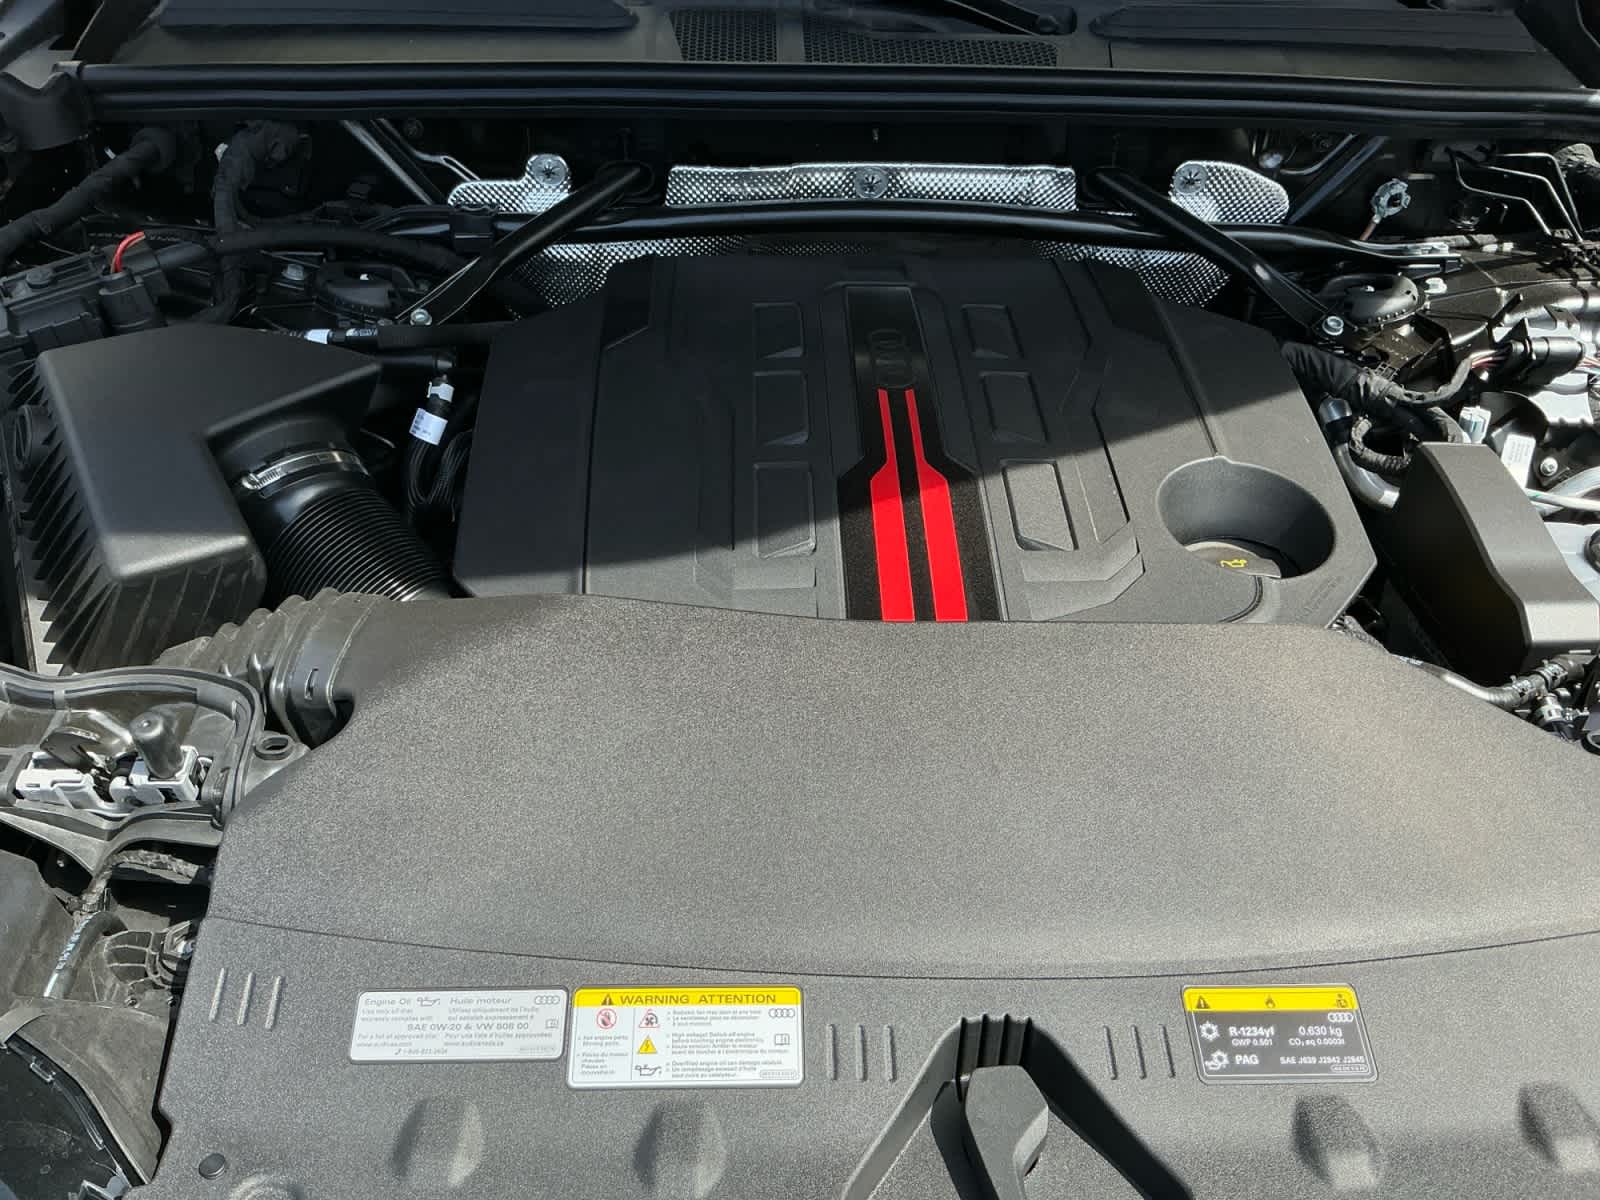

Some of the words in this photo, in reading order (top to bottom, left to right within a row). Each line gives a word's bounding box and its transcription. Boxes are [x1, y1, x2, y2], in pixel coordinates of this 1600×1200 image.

[365, 998, 397, 1007] Engine
[399, 998, 412, 1006] Oil
[476, 997, 512, 1005] moteur
[619, 994, 690, 1005] WARNING
[697, 993, 777, 1004] ATTENTION
[407, 1023, 428, 1031] SAE
[430, 1022, 462, 1031] 0W-20
[476, 1022, 494, 1030] VW
[516, 1022, 529, 1030] 00
[1228, 1026, 1275, 1038] R-1234yf
[1329, 1025, 1344, 1038] kg
[1234, 1053, 1260, 1065] PAG
[1279, 1056, 1297, 1065] SAE
